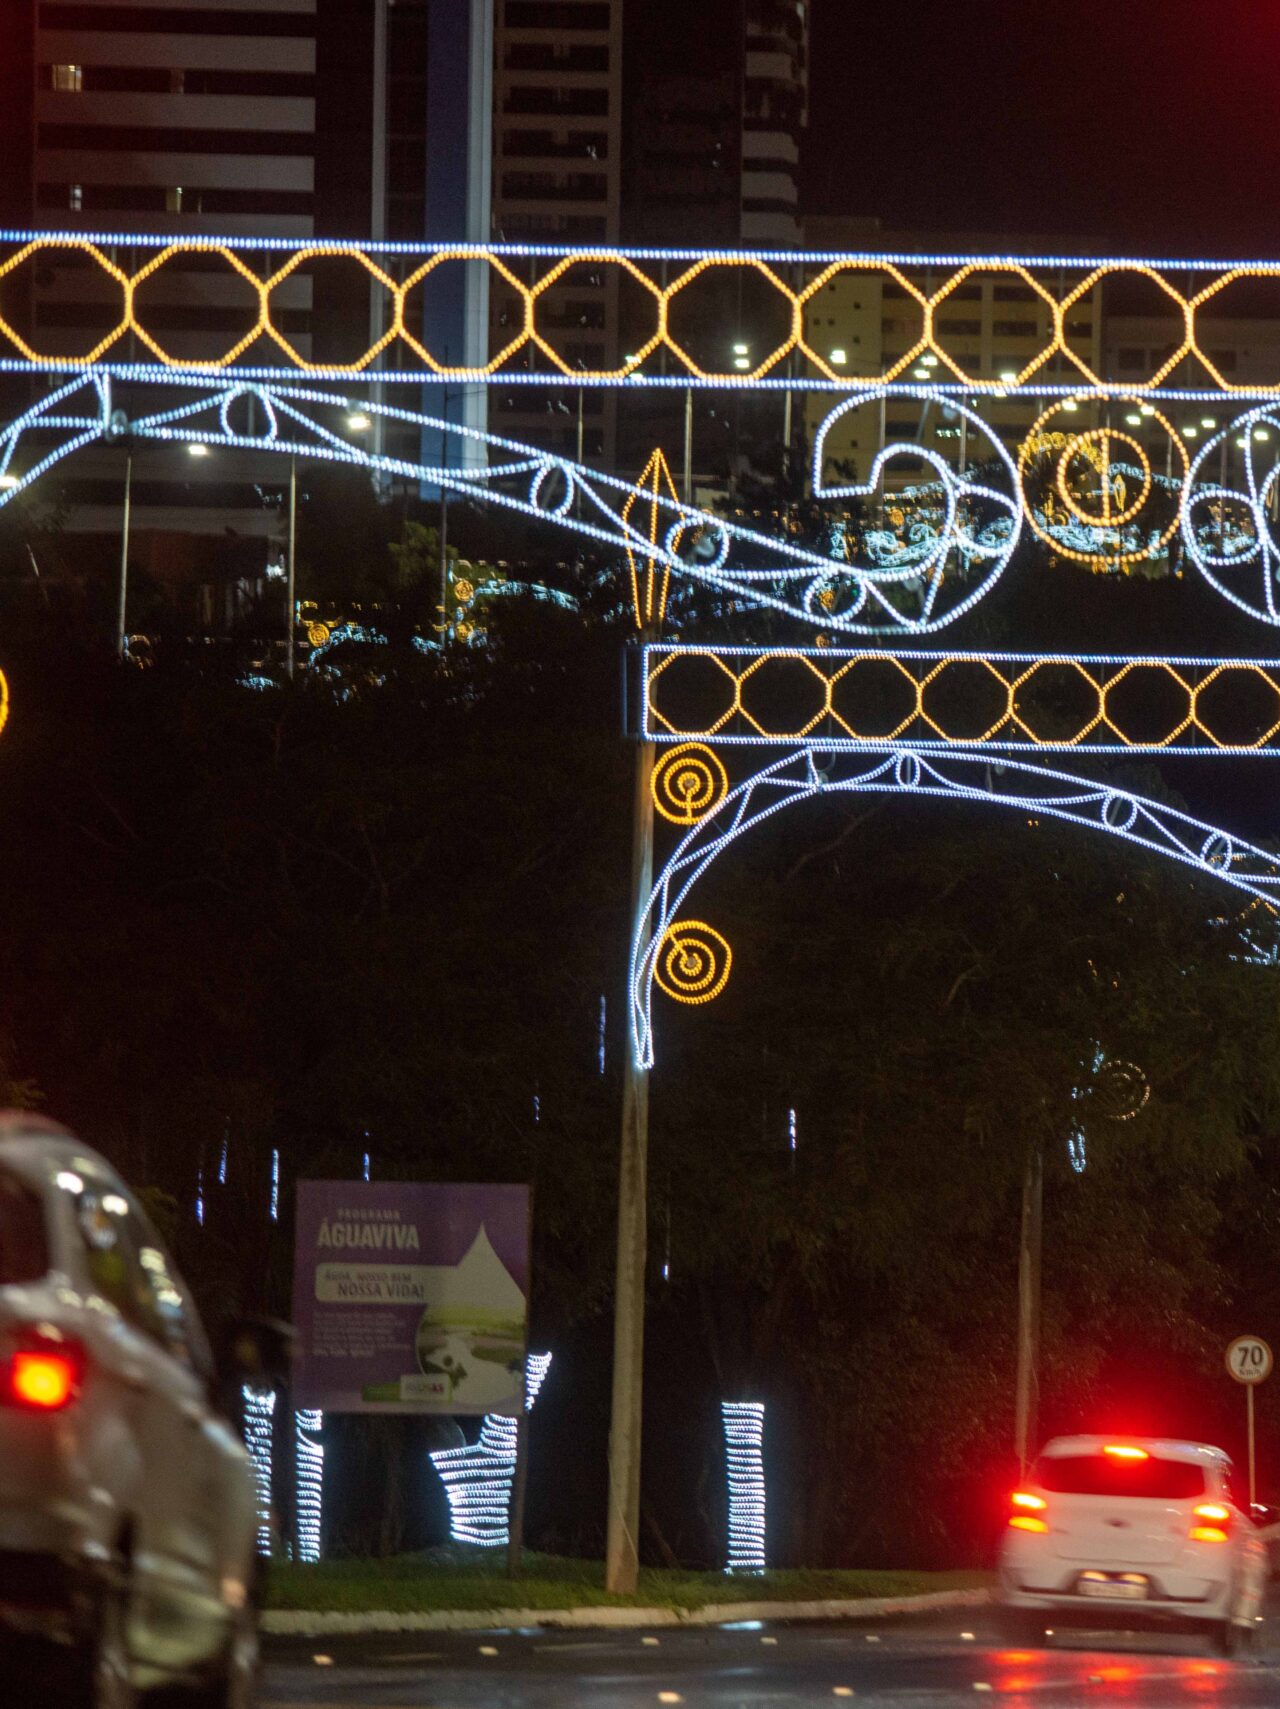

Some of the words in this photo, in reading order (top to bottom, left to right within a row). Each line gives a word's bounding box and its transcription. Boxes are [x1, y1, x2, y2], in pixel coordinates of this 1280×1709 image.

[338, 1282, 382, 1297] NOSSA
[387, 1283, 425, 1299] VIDA!
[1238, 1345, 1264, 1367] 70
